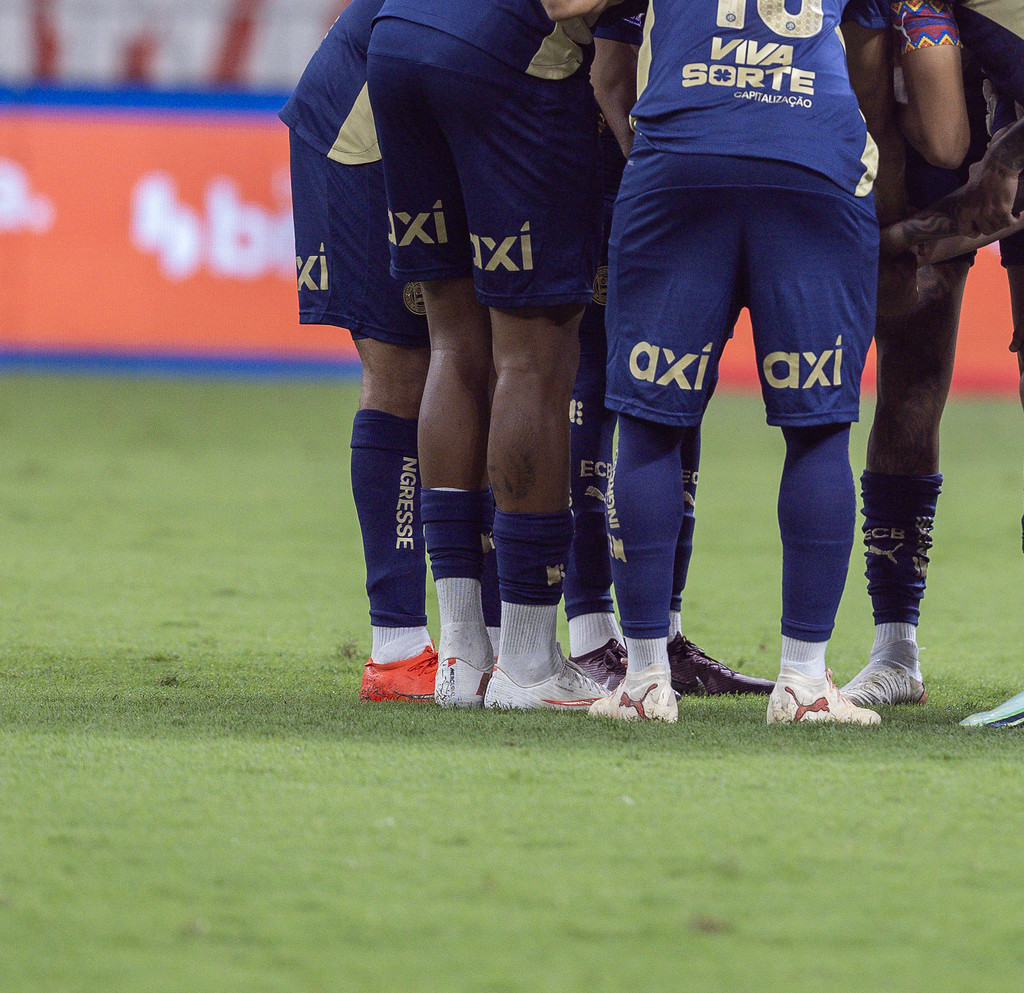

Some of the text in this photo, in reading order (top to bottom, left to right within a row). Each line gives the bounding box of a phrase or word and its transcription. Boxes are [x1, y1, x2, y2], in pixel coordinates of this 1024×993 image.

[710, 36, 795, 67] VIVA
[681, 62, 816, 96] SORTE
[733, 90, 813, 109] CAPITALIZAÇÃO
[395, 456, 418, 550] NGRESSE
